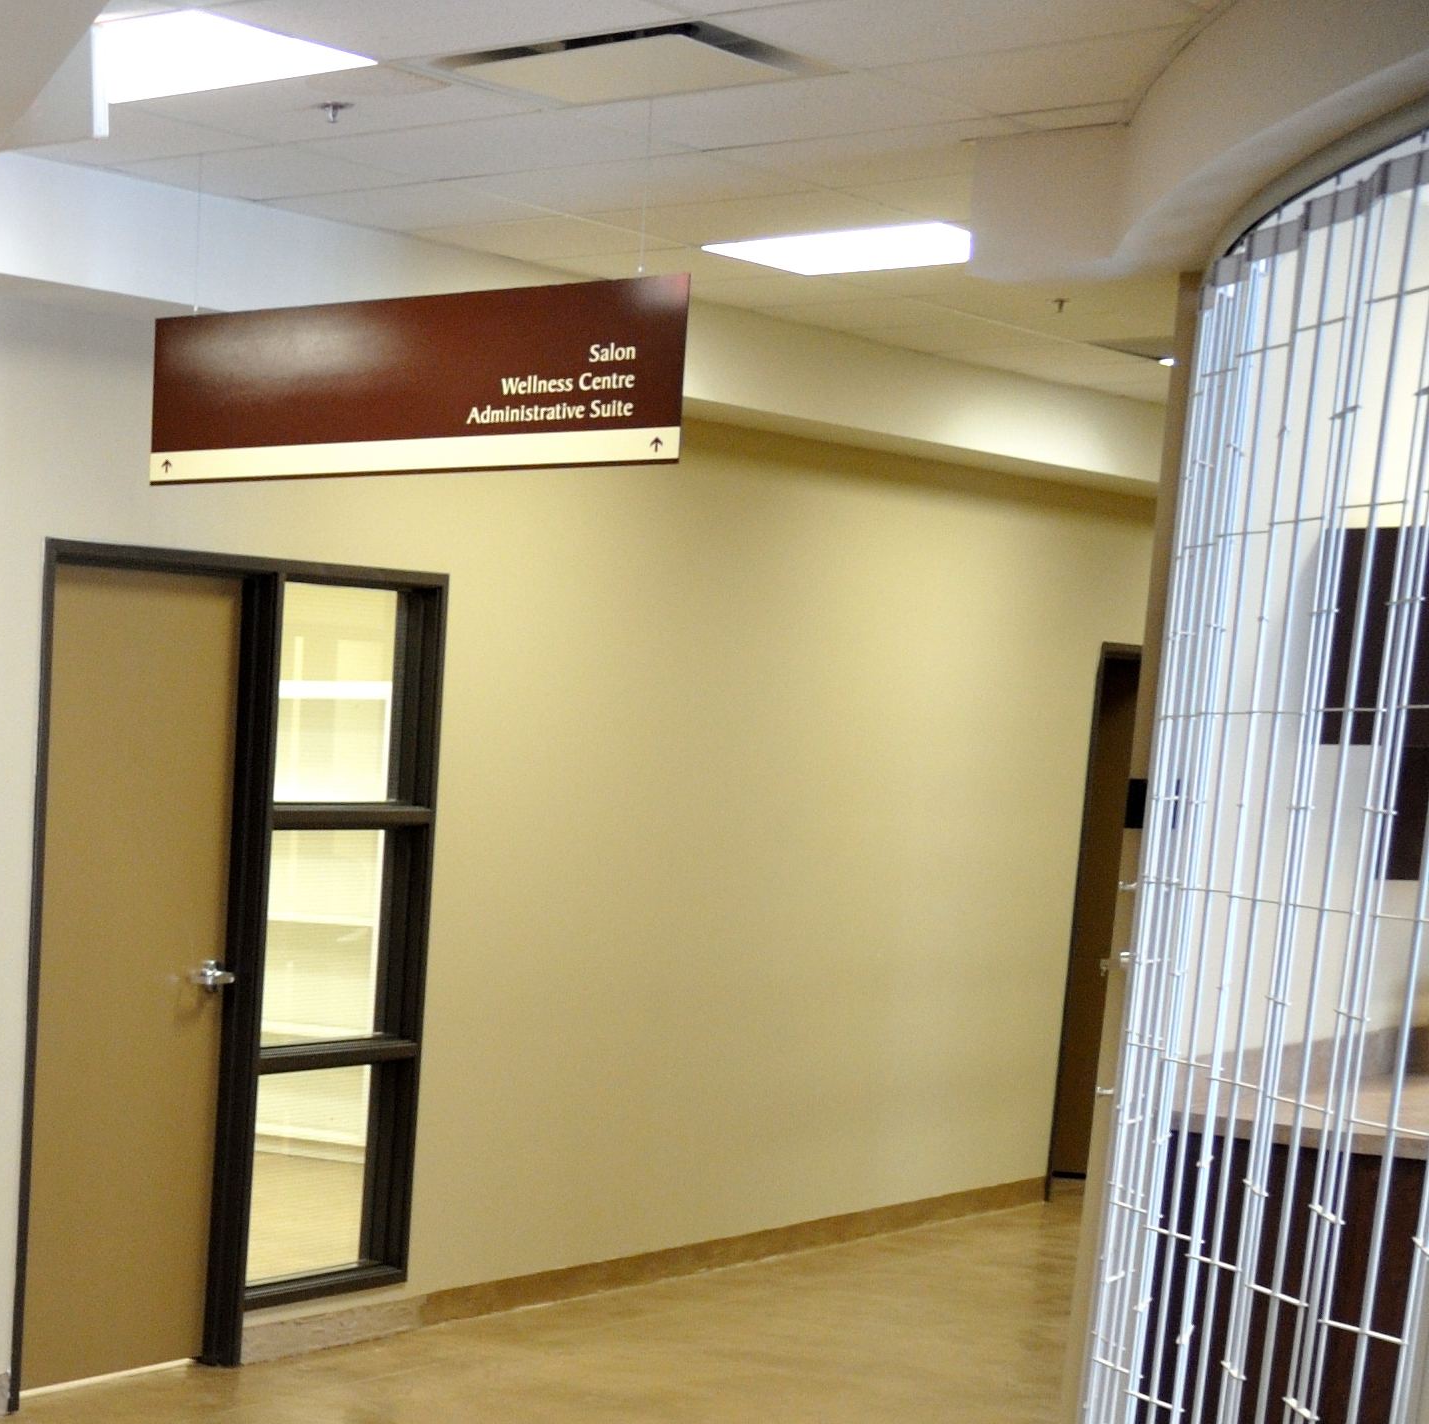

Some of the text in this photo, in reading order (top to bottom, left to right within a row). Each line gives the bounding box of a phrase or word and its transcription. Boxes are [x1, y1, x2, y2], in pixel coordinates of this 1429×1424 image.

[589, 342, 636, 362] Salon
[501, 372, 635, 395] Wellness Centre
[466, 400, 634, 425] Administrative Suite
